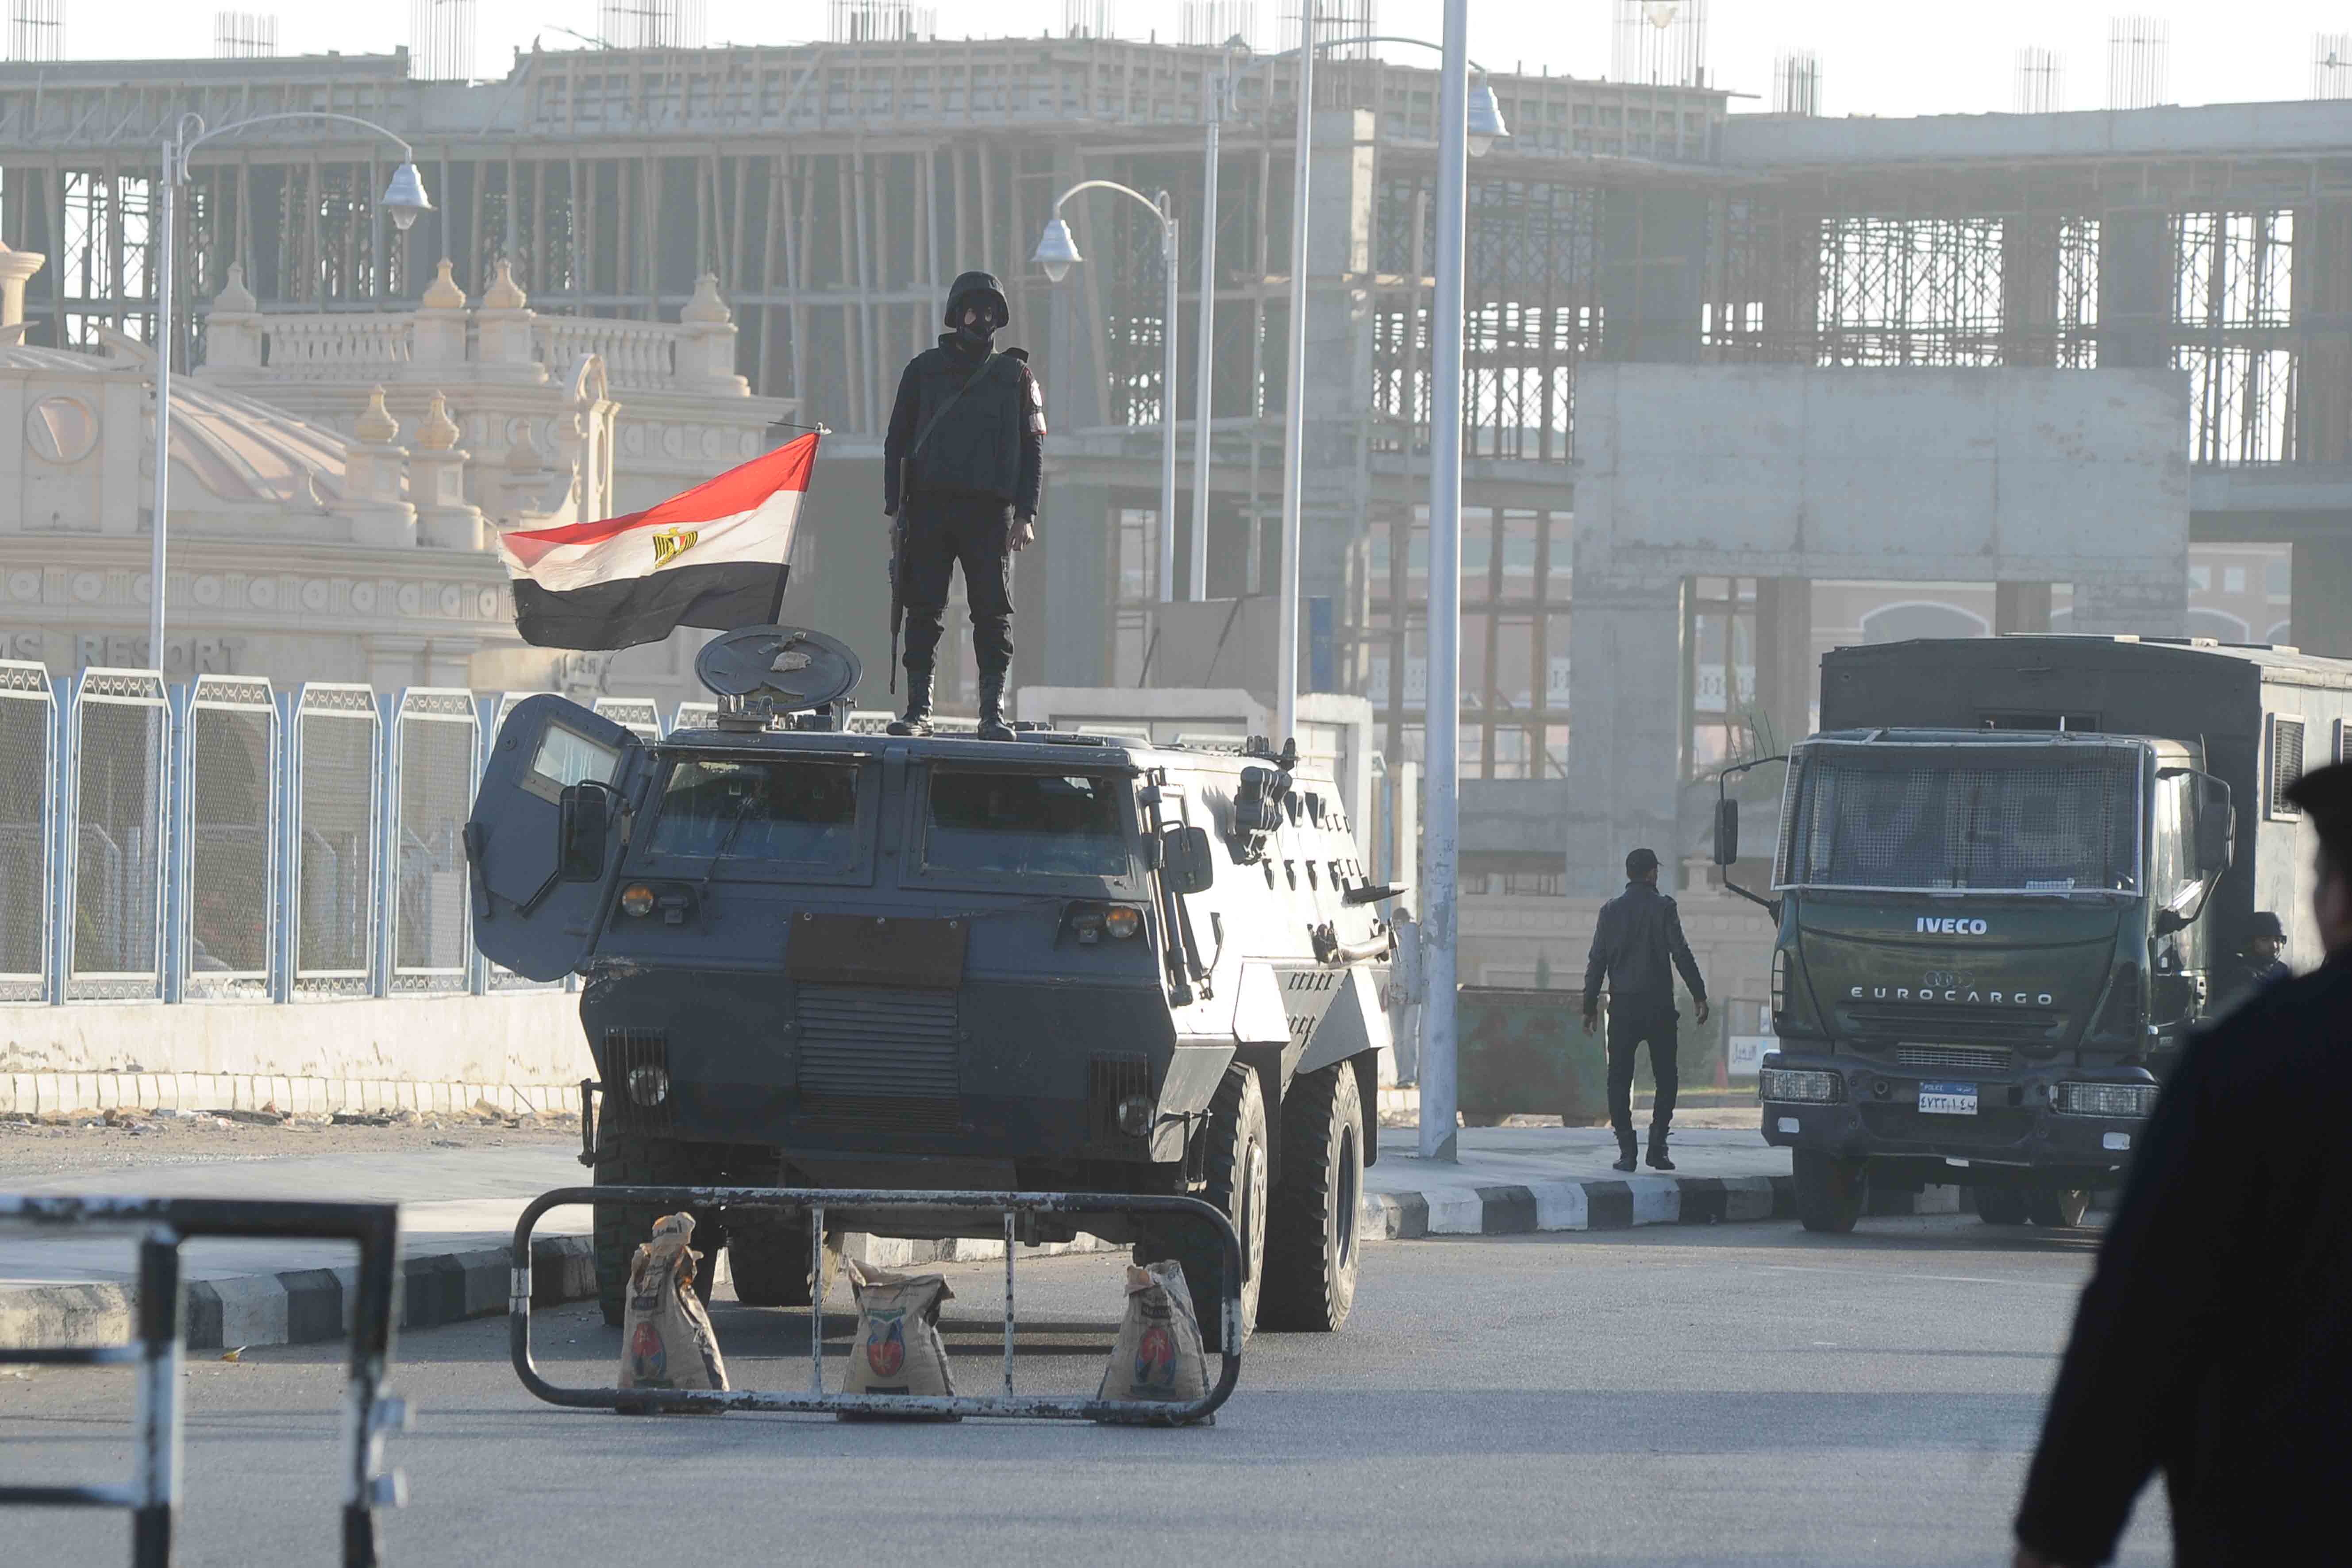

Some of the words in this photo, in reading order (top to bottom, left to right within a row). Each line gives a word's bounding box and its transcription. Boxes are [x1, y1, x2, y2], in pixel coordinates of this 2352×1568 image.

[76, 635, 246, 674] RESORT
[1917, 917, 1987, 935] IVECO
[1851, 986, 2052, 1005] EUROCARGO
